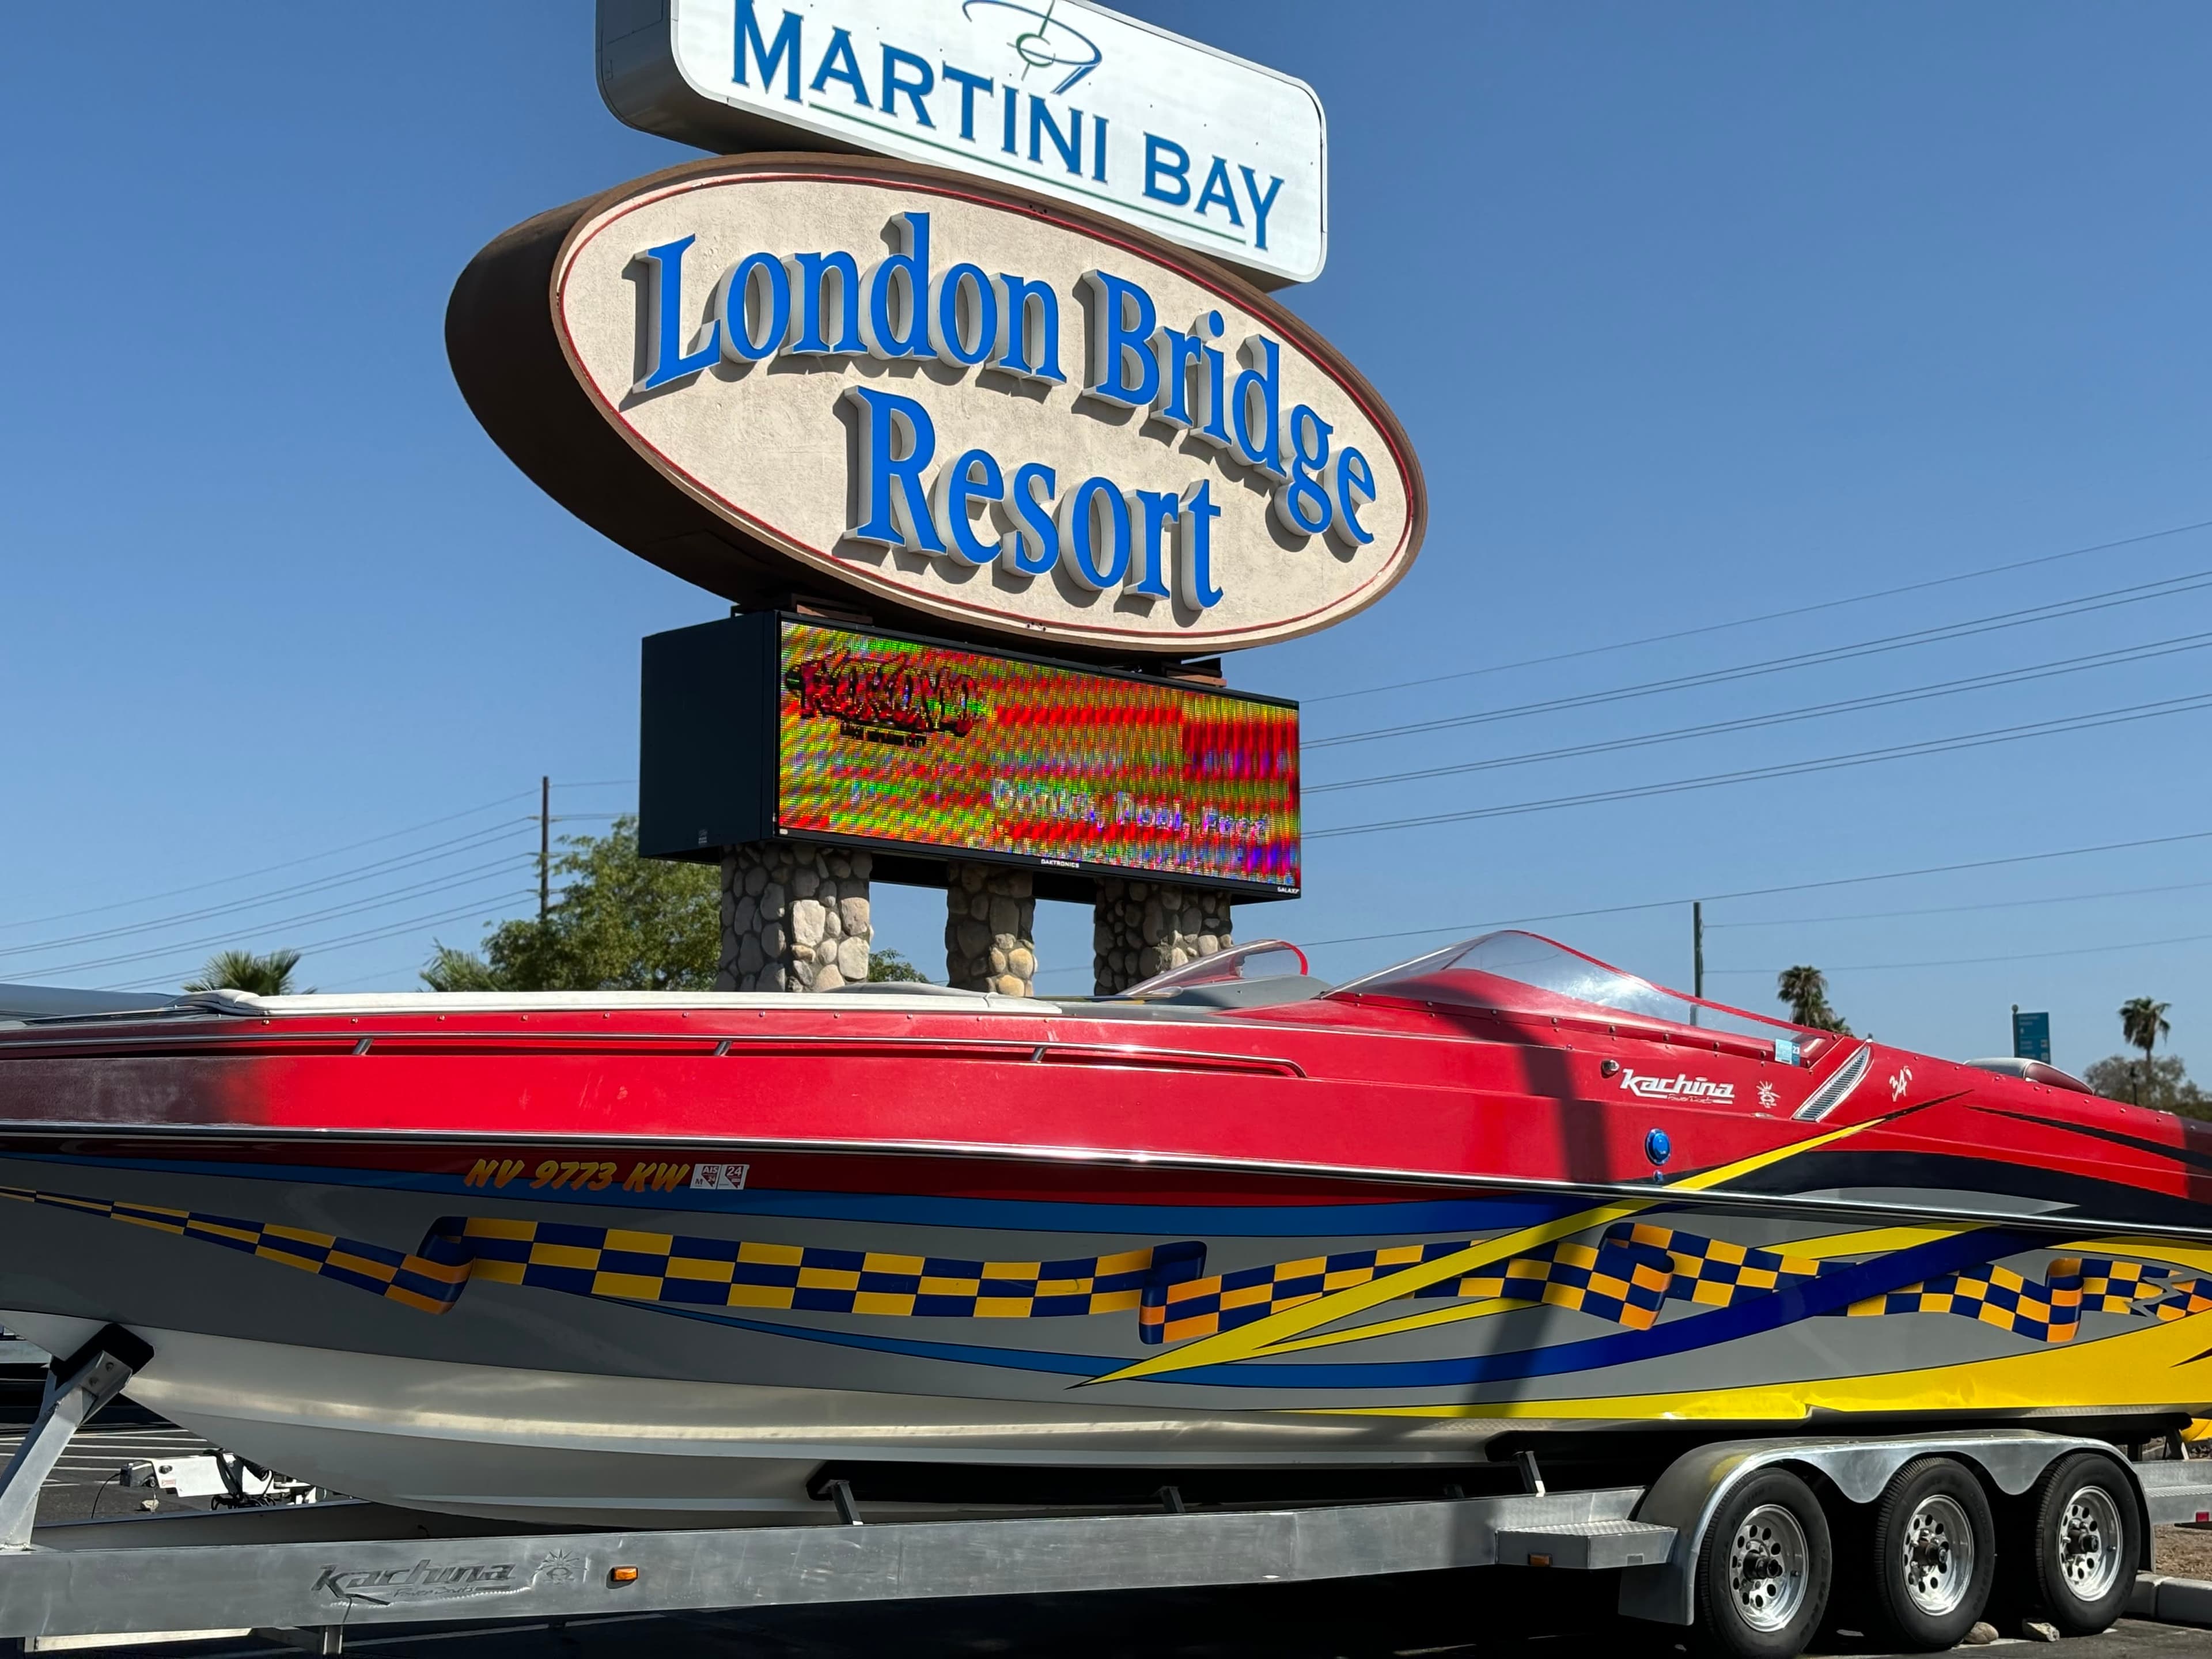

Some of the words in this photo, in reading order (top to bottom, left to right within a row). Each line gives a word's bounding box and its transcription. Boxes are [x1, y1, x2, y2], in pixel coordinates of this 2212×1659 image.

[732, 0, 1109, 184] MARTINI
[1143, 131, 1285, 251] BAY
[633, 211, 1067, 395] London
[1084, 268, 1377, 547] Bridge
[845, 386, 1225, 611] Resort
[1041, 858, 1080, 868] DAKTRONICS
[1619, 1069, 1735, 1103] Kachina
[464, 1159, 525, 1189] NV
[529, 1160, 618, 1191] 9773
[622, 1162, 691, 1193] KW
[727, 1166, 742, 1176] 24
[310, 1559, 516, 1605] Kachina
